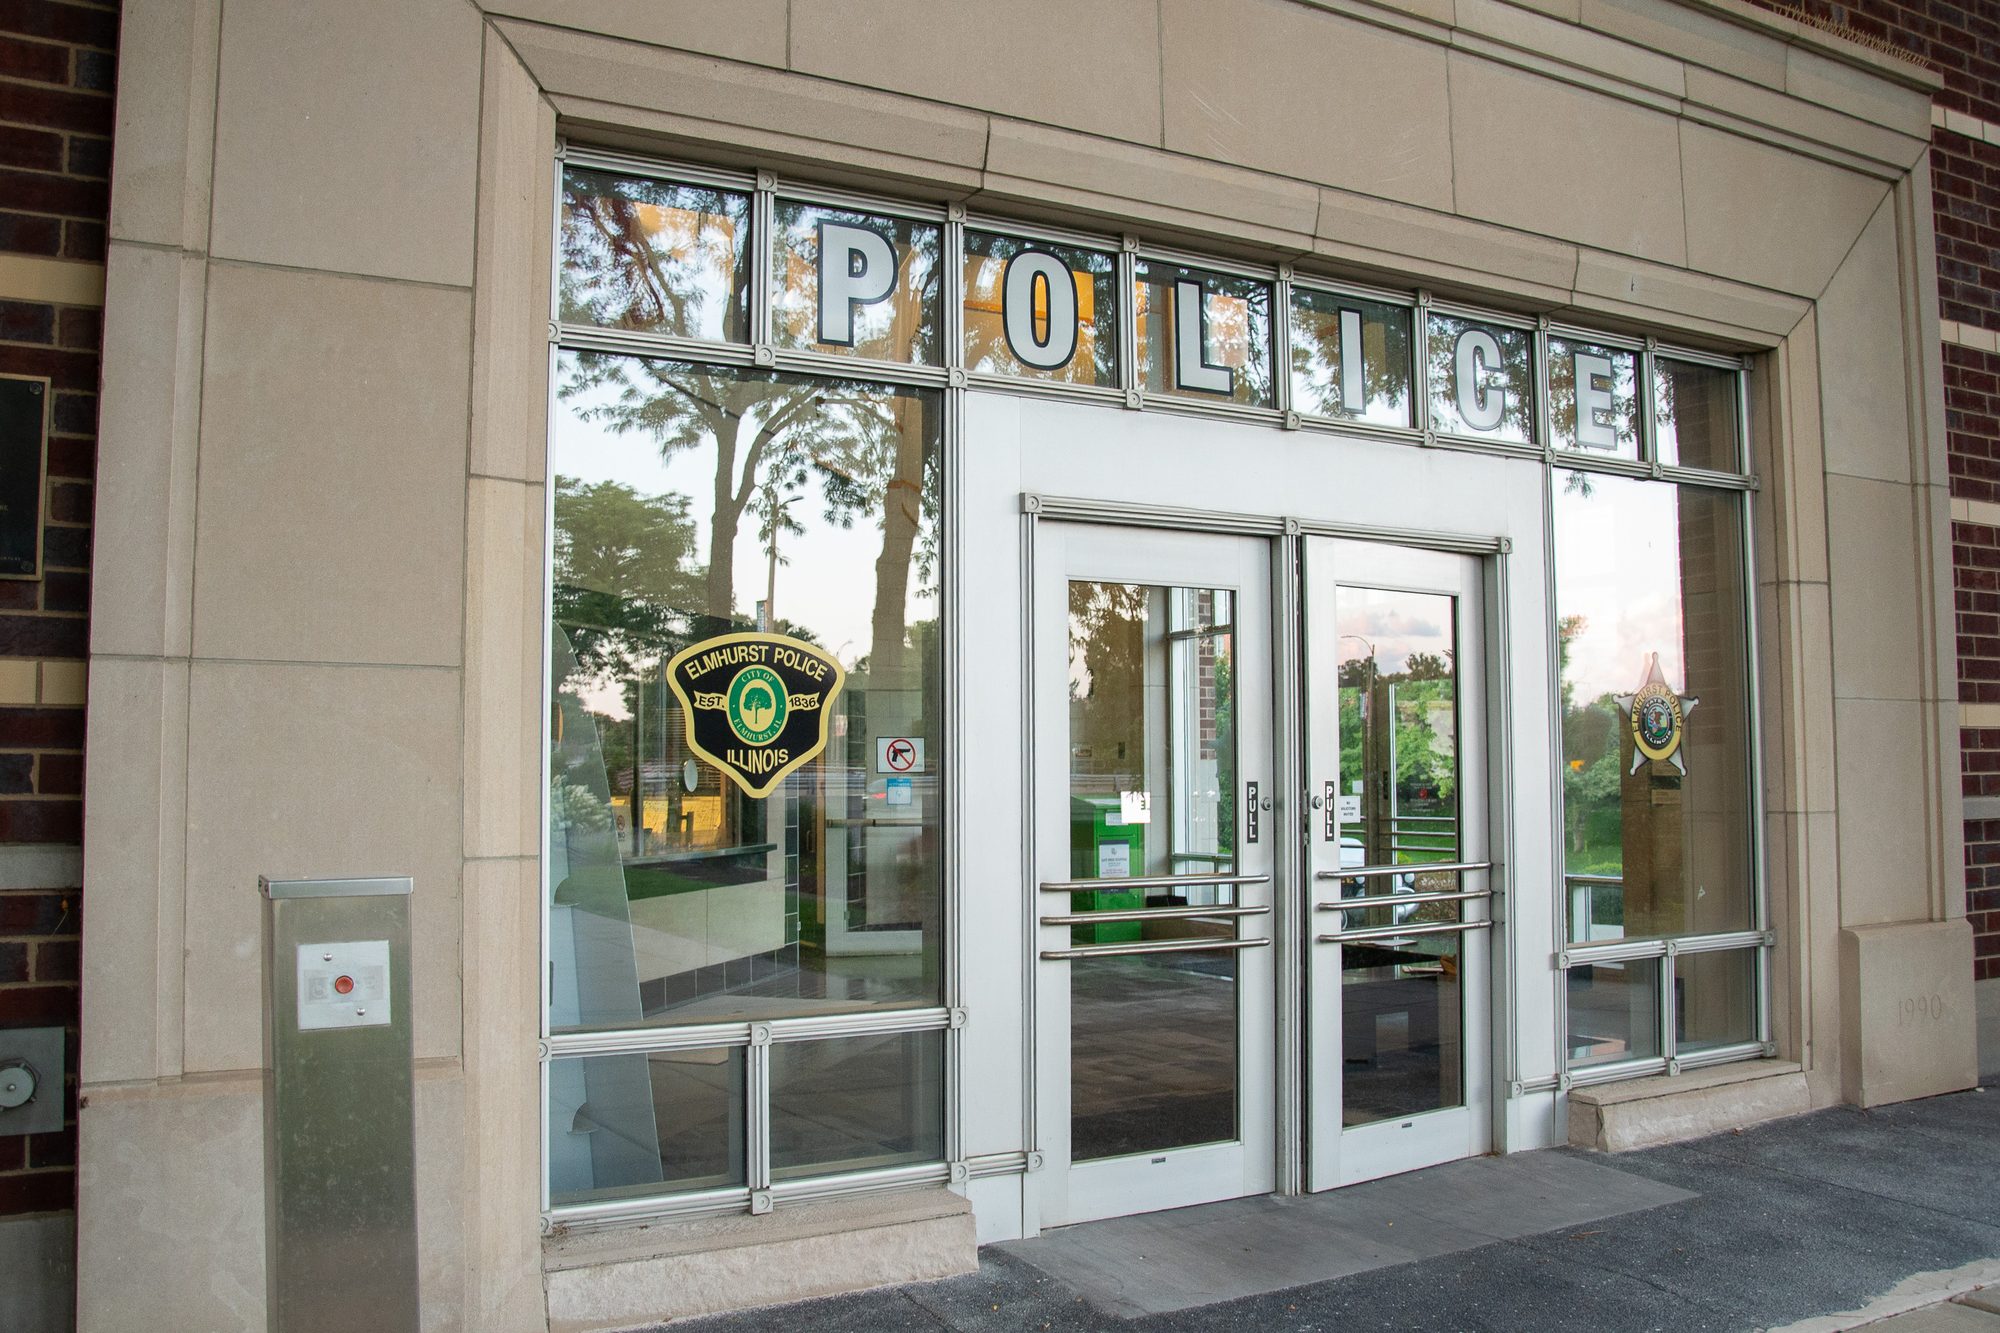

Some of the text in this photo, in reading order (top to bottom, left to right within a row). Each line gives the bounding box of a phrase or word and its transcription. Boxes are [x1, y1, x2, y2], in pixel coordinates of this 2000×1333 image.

[816, 217, 1618, 451] POLICE
[684, 645, 828, 682] ELMHURST POLICE
[741, 670, 775, 683] CITY OF
[698, 696, 816, 708] EST. 1836
[1631, 684, 1682, 733] ELMHURST POLICE
[773, 719, 783, 729] IL
[1644, 730, 1672, 745] ILLINOIS
[726, 748, 789, 775] ILLINOIS
[1248, 786, 1257, 838] PULL
[1899, 993, 1942, 1026] 1990
